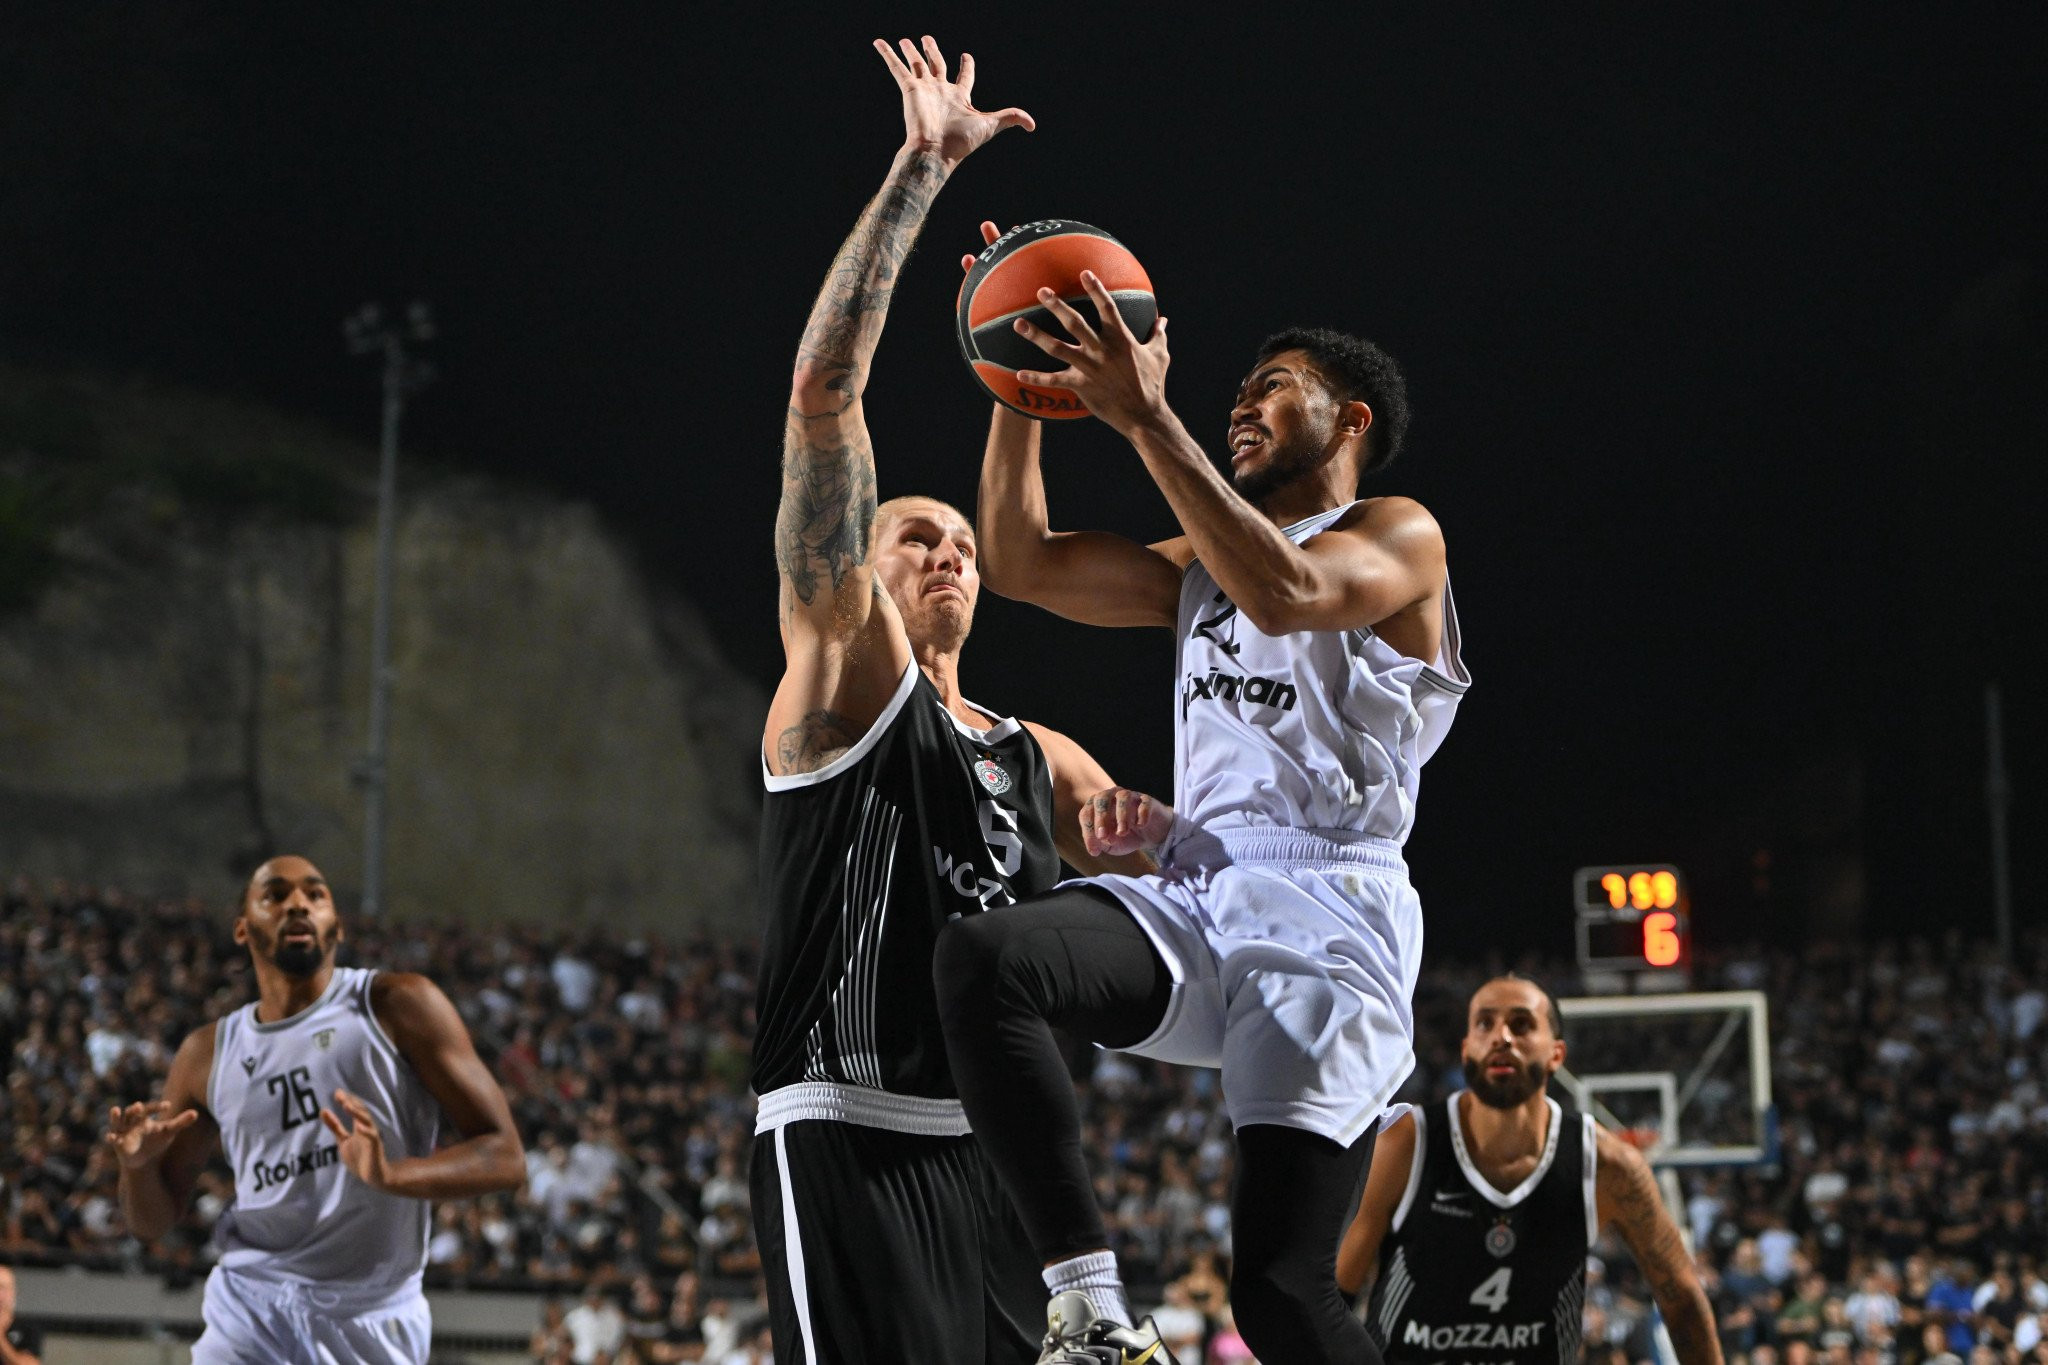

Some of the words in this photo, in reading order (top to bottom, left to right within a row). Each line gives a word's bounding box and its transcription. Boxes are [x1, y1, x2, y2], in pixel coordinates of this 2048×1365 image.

[1017, 387, 1087, 411] SPAL
[979, 799, 1023, 878] 5
[933, 845, 1017, 912] MOZ
[1643, 912, 1680, 966] 6
[267, 1065, 320, 1131] 26
[1469, 1266, 1513, 1314] 4
[1403, 1319, 1546, 1350] MOZZART
